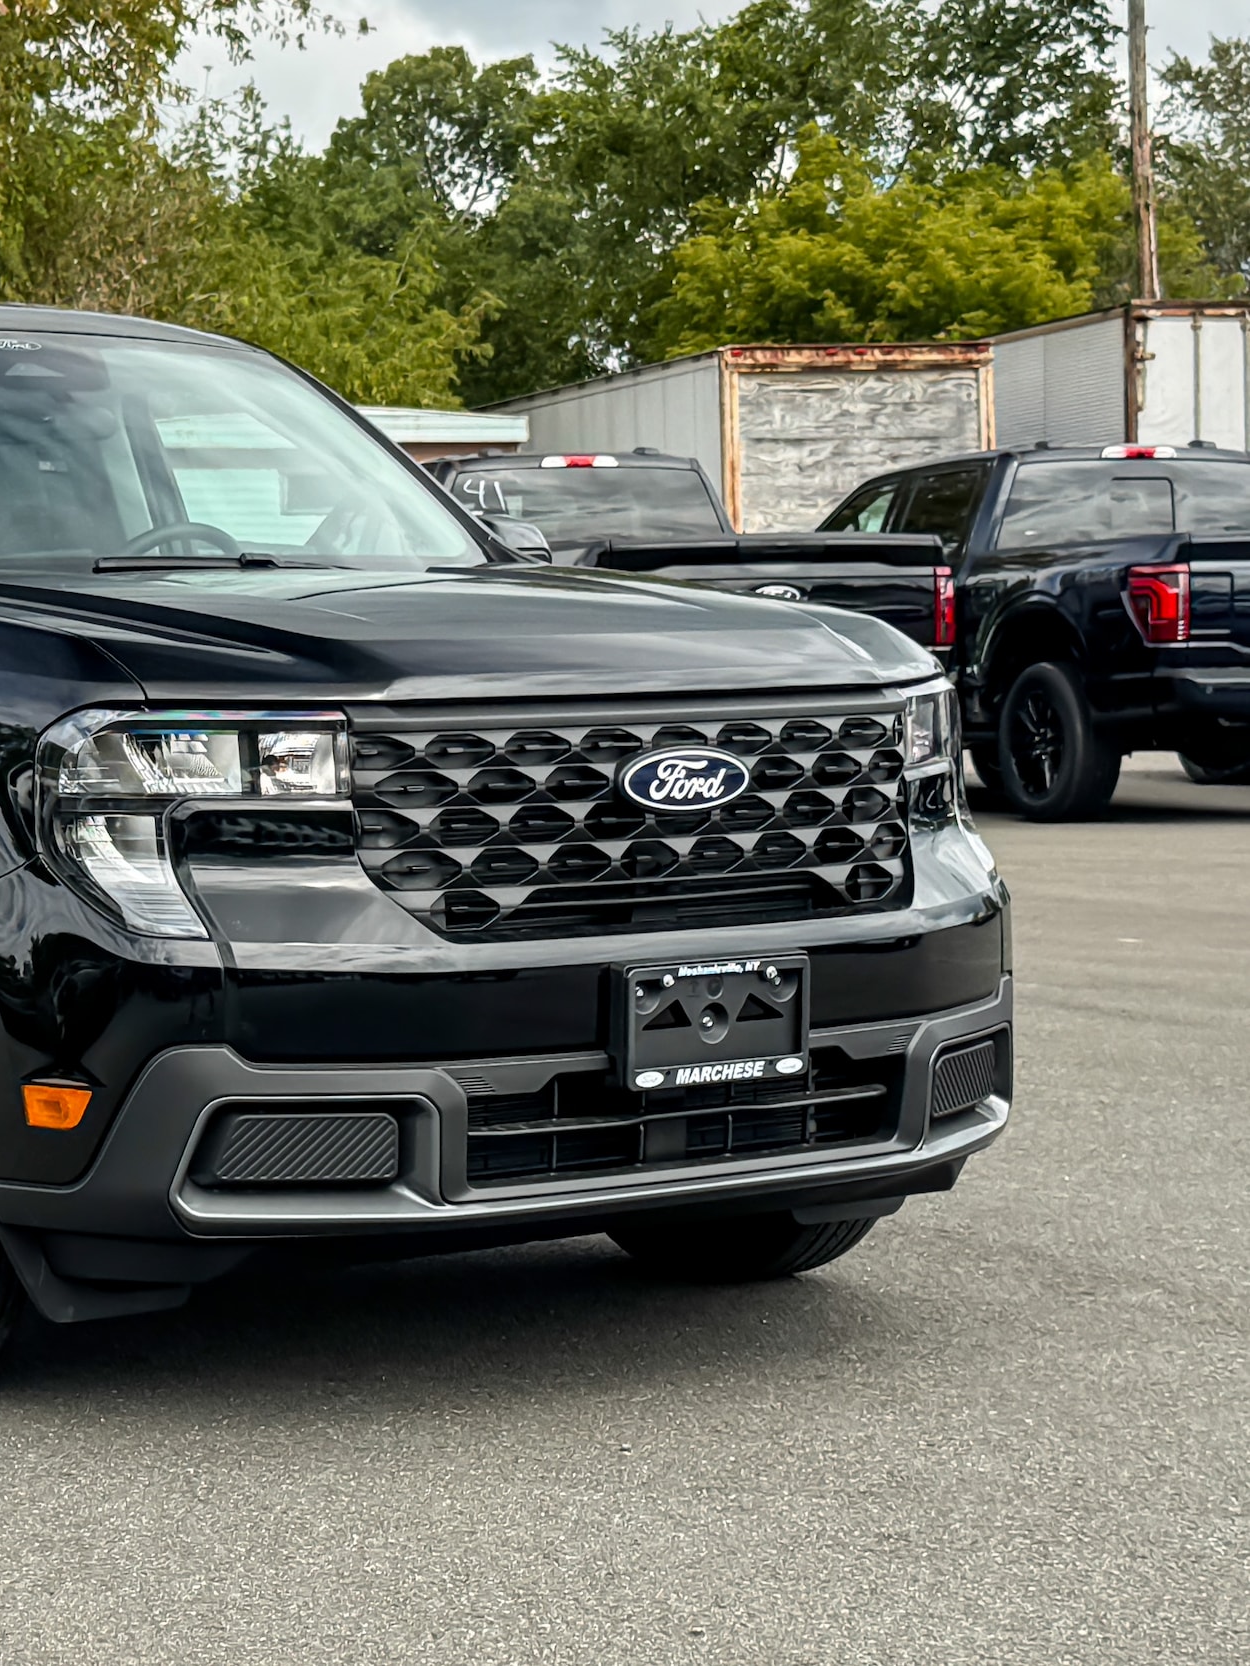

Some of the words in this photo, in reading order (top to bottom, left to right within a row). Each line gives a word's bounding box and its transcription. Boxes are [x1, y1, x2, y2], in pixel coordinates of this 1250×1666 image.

[463, 478, 506, 511] 41
[649, 759, 727, 800] Ford
[745, 961, 761, 972] NY
[675, 1060, 766, 1085] MARCHESE
